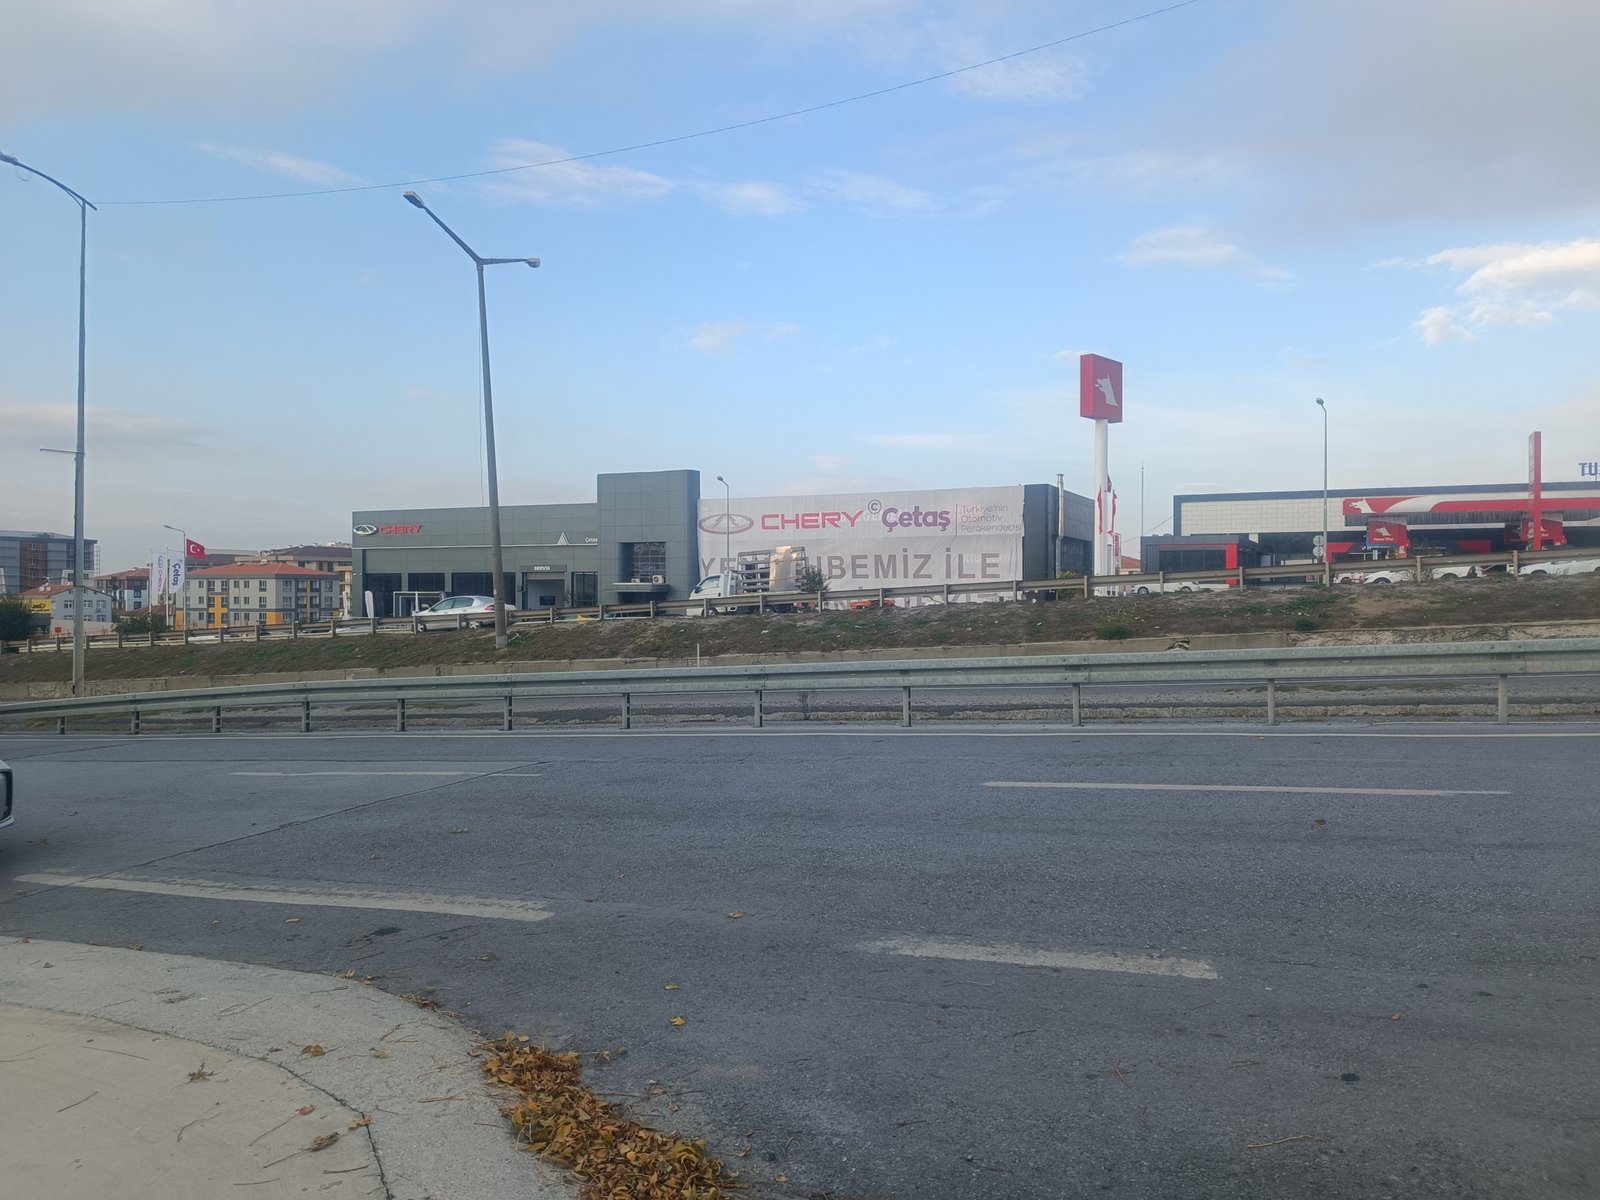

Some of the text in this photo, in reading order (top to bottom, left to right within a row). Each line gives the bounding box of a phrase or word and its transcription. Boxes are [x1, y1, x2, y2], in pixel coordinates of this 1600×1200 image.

[761, 511, 864, 530] CHERY
[882, 506, 951, 533] Çetaş
[961, 515, 1002, 523] Otomotiv
[381, 524, 423, 534] CHERY
[946, 547, 1000, 579] İLE
